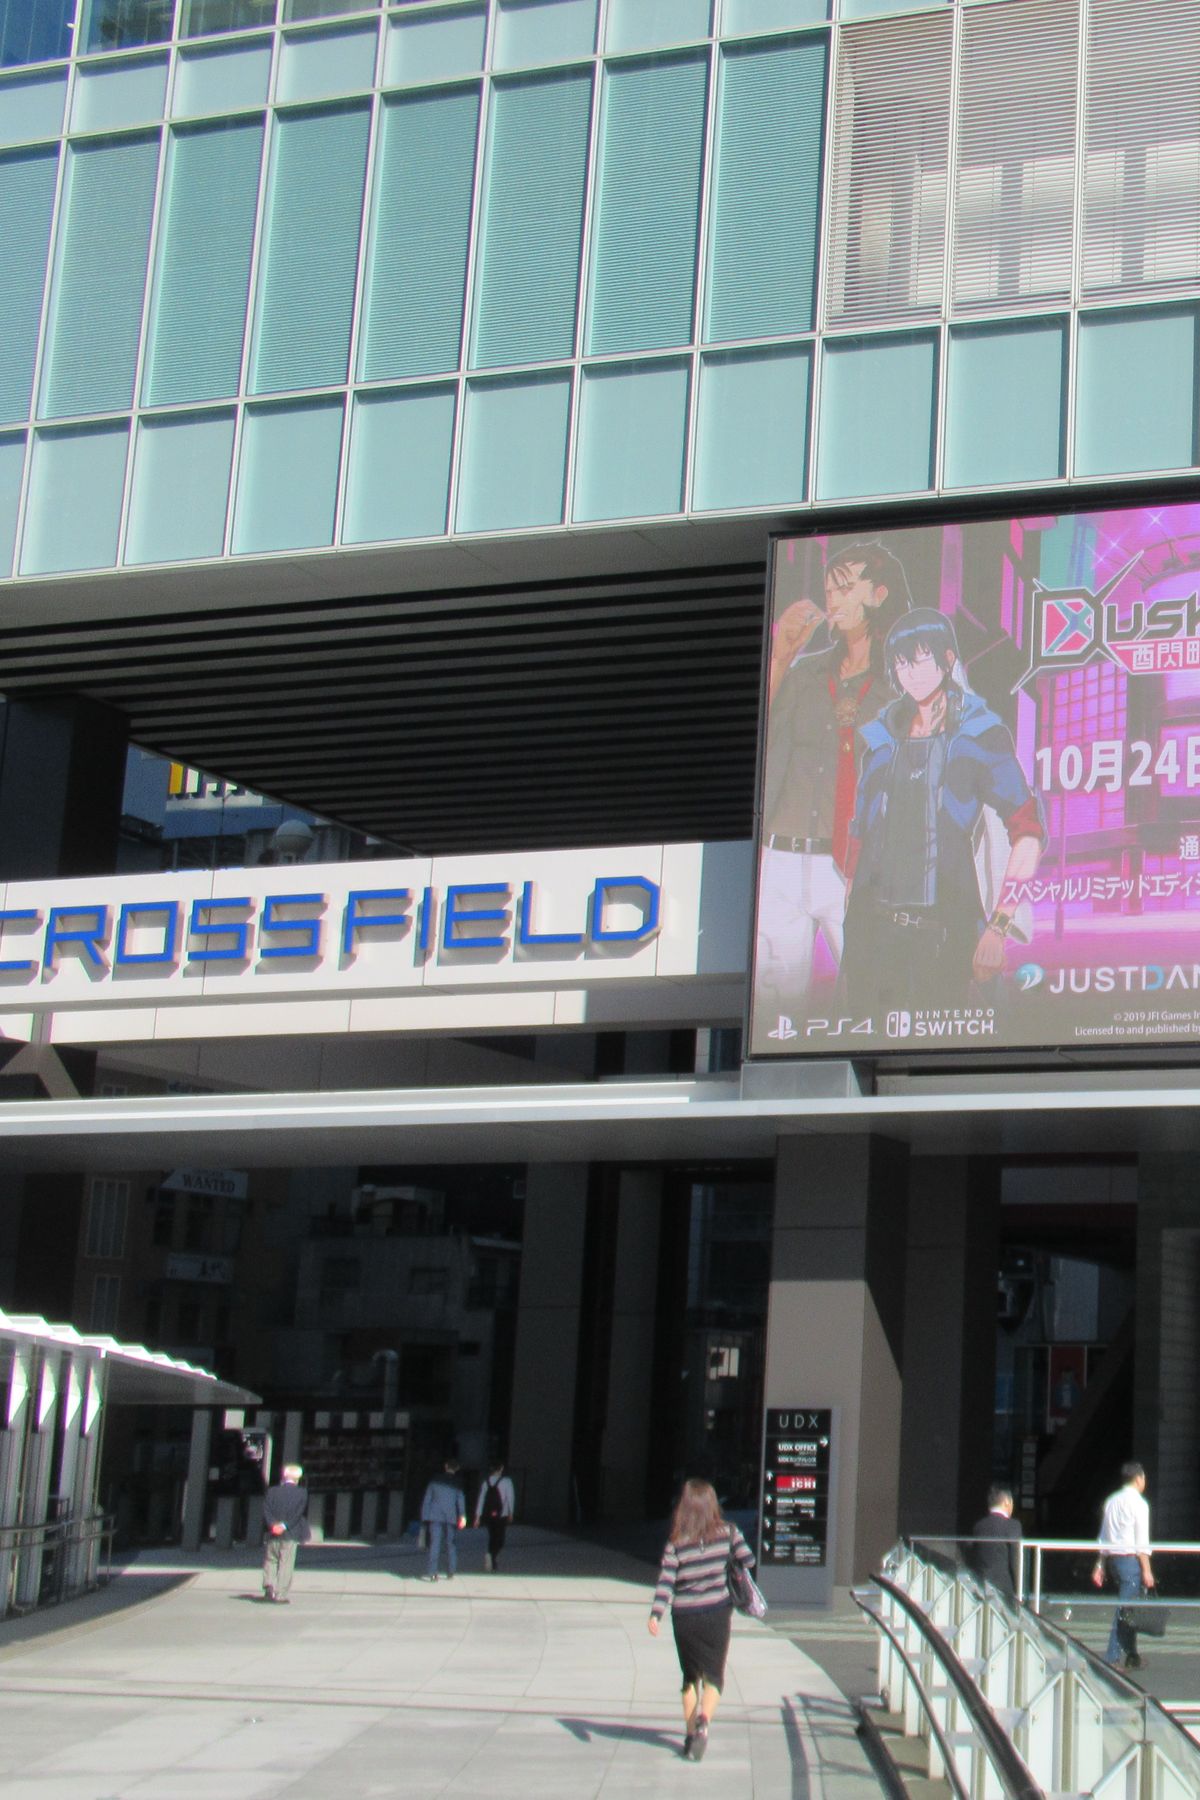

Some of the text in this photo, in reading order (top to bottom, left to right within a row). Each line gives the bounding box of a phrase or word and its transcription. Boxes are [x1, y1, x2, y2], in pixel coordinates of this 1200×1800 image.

[0, 876, 660, 972] CROSSFIELD
[915, 1008, 995, 1019] NINTENDO
[1124, 1011, 1146, 1021] 2019
[1161, 1010, 1191, 1020] Games
[1075, 1026, 1113, 1036] Licensed
[1115, 1026, 1125, 1034] to
[1126, 1024, 1144, 1034] and
[1145, 1023, 1190, 1036] published
[778, 1414, 819, 1428] UDX
